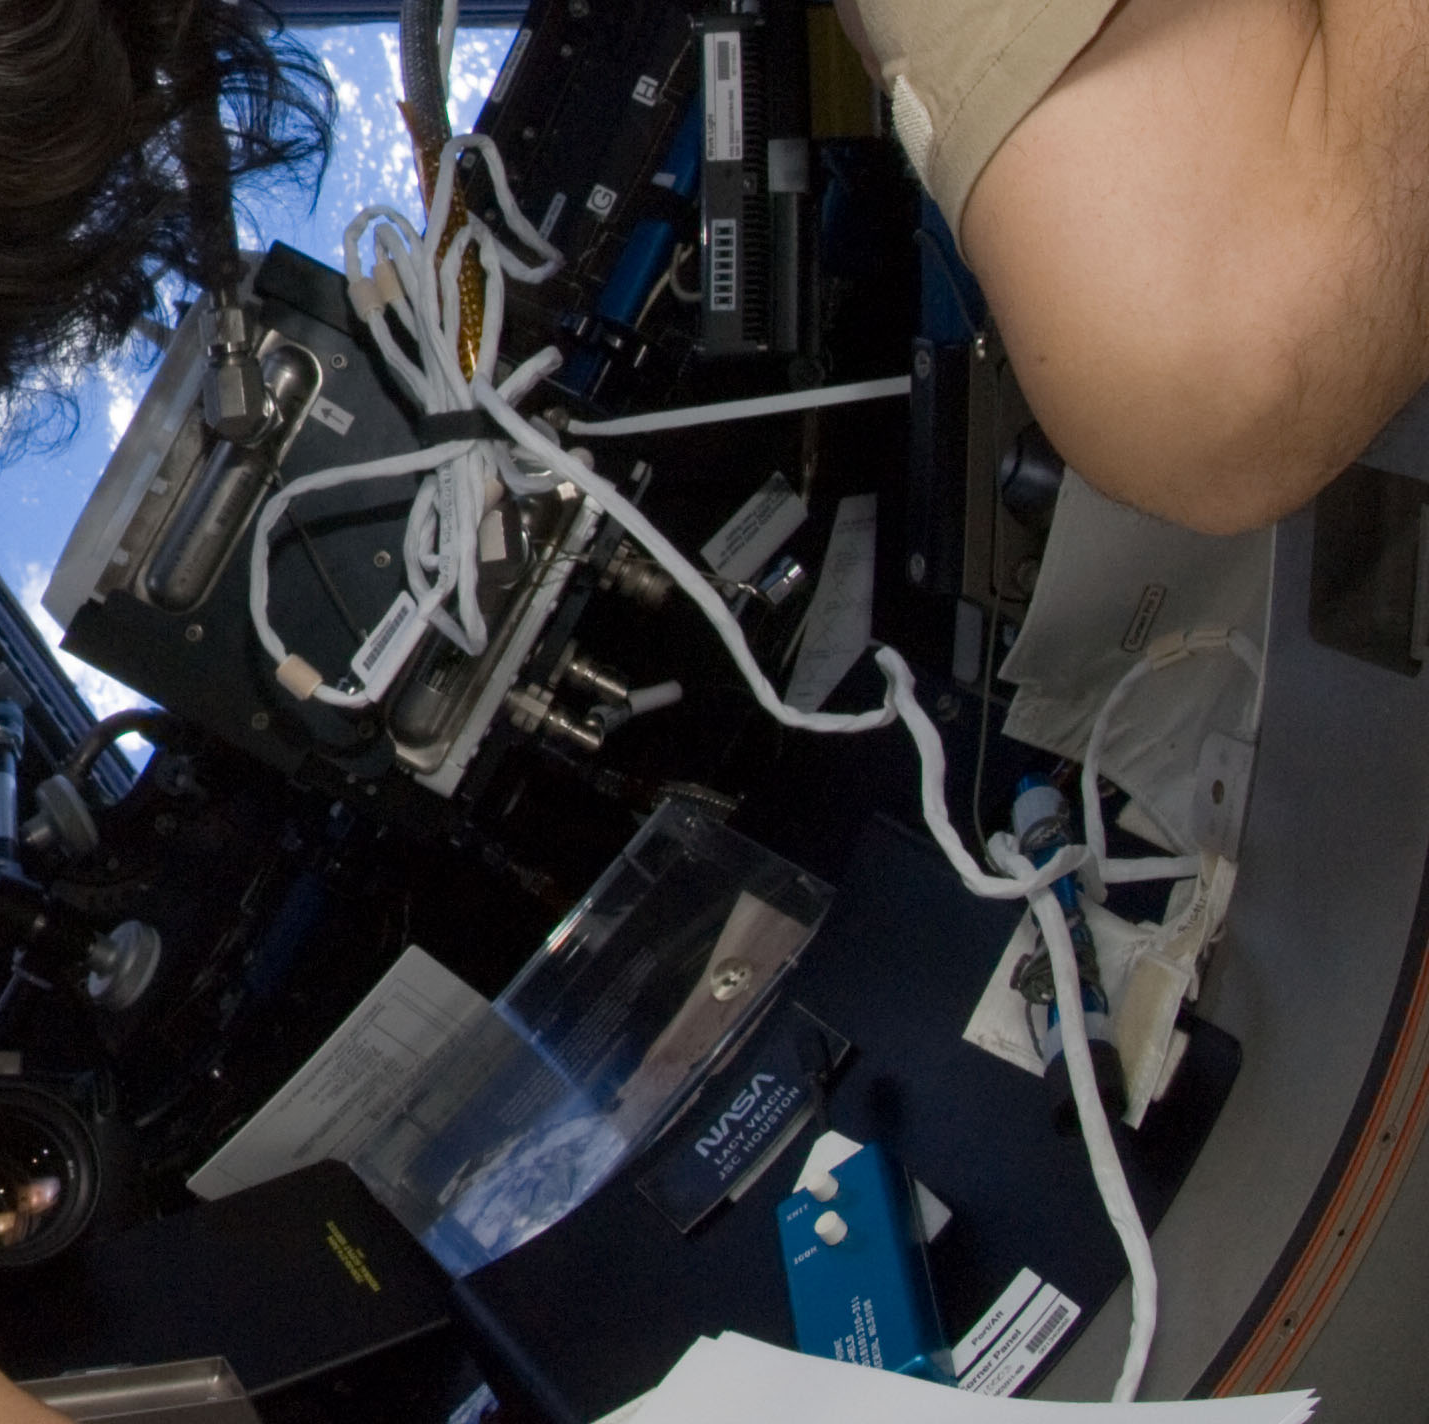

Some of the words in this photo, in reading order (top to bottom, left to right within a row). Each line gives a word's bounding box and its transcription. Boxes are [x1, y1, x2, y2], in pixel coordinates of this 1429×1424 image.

[634, 78, 658, 100] H
[707, 113, 715, 134] Light
[589, 188, 613, 211] G
[694, 1073, 775, 1158] NASA
[714, 1132, 745, 1165] LACY
[746, 1085, 786, 1128] VEACH
[718, 1155, 741, 1181] JSC
[743, 1086, 800, 1153] HOUSTON
[969, 1309, 1005, 1347] Port/Aft
[991, 1327, 1022, 1360] Panel
